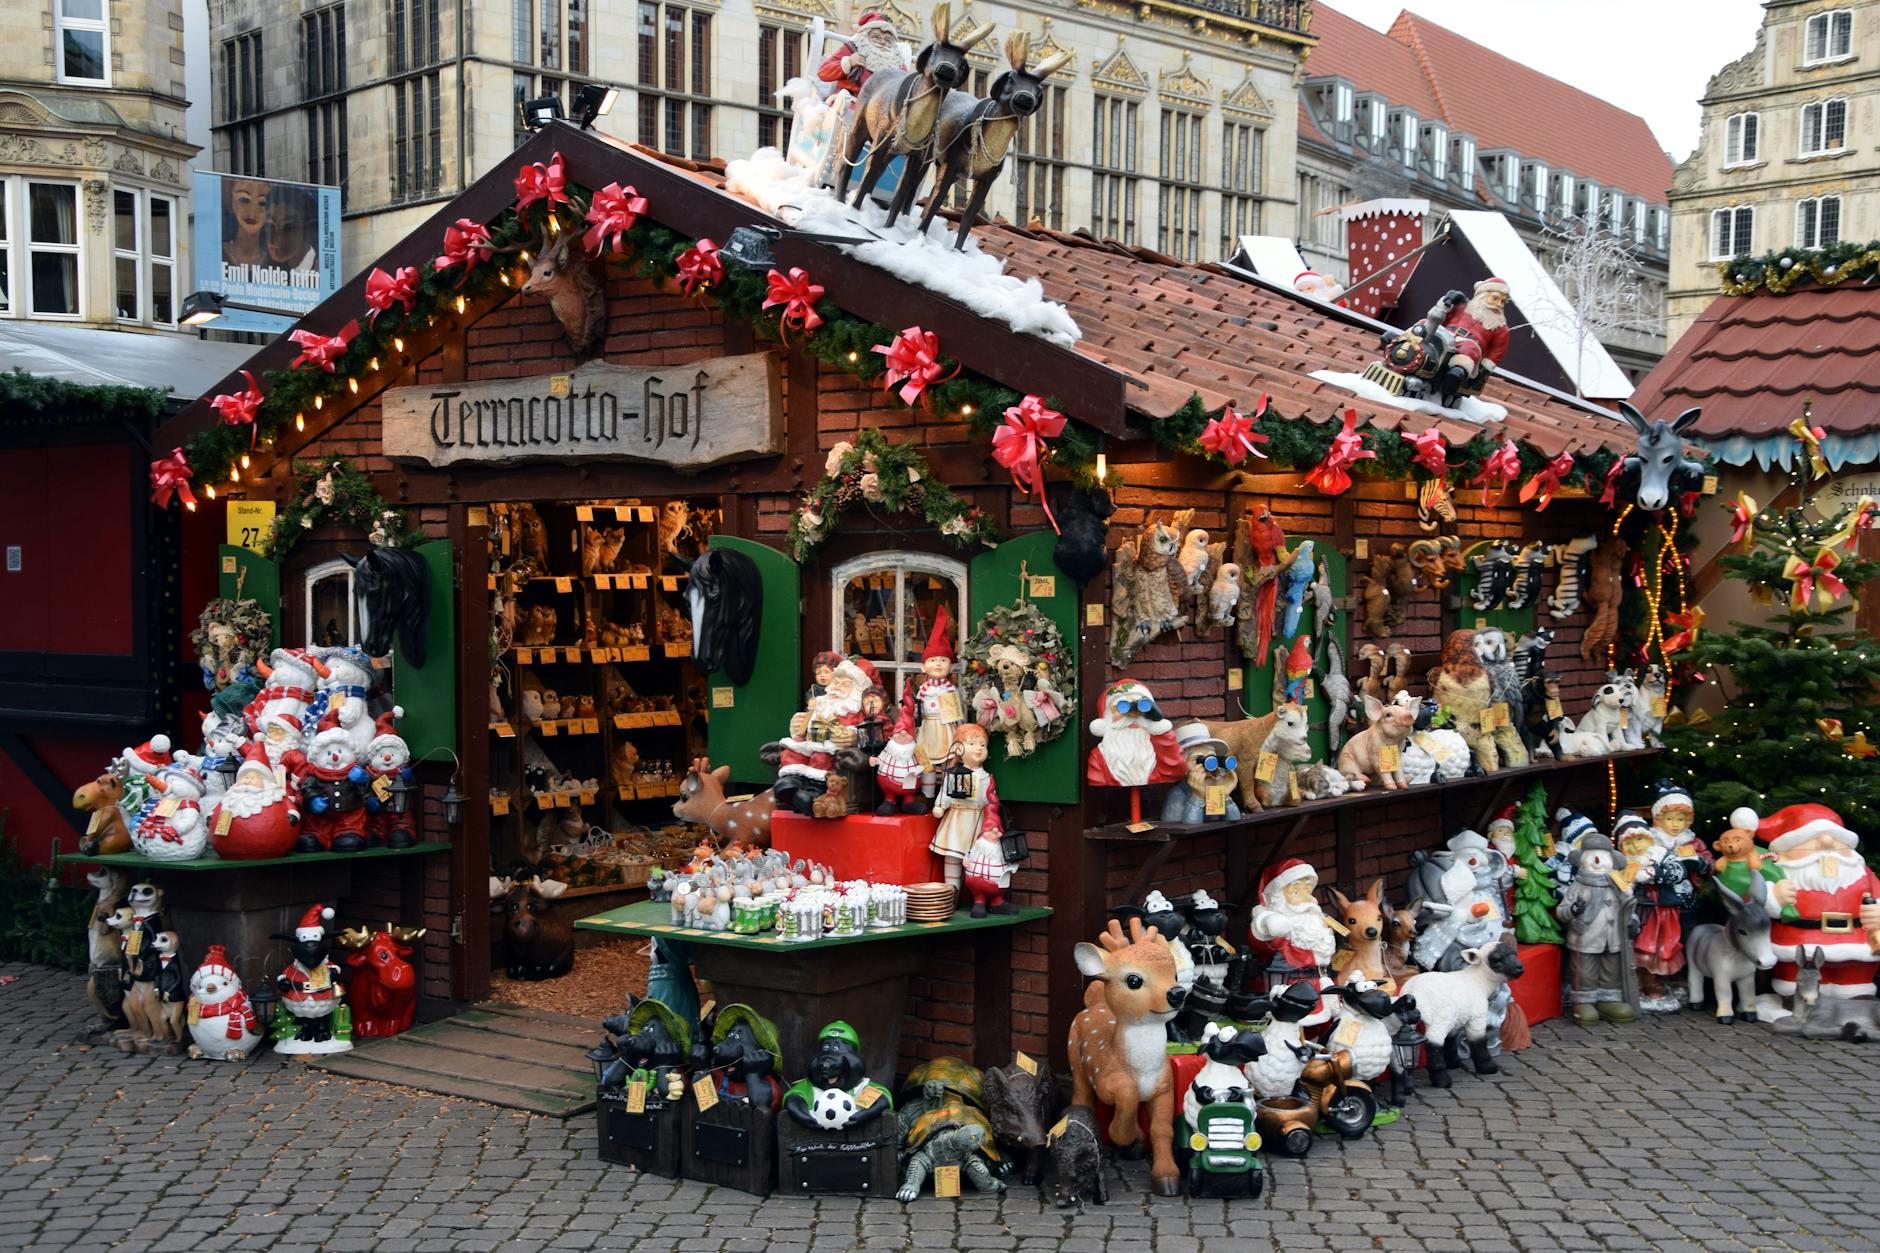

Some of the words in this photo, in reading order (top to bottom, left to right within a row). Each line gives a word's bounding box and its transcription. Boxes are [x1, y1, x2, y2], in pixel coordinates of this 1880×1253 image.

[221, 261, 249, 283] Emil
[251, 264, 288, 287] Nolde
[290, 268, 320, 289] trifft
[242, 527, 259, 548] 27
